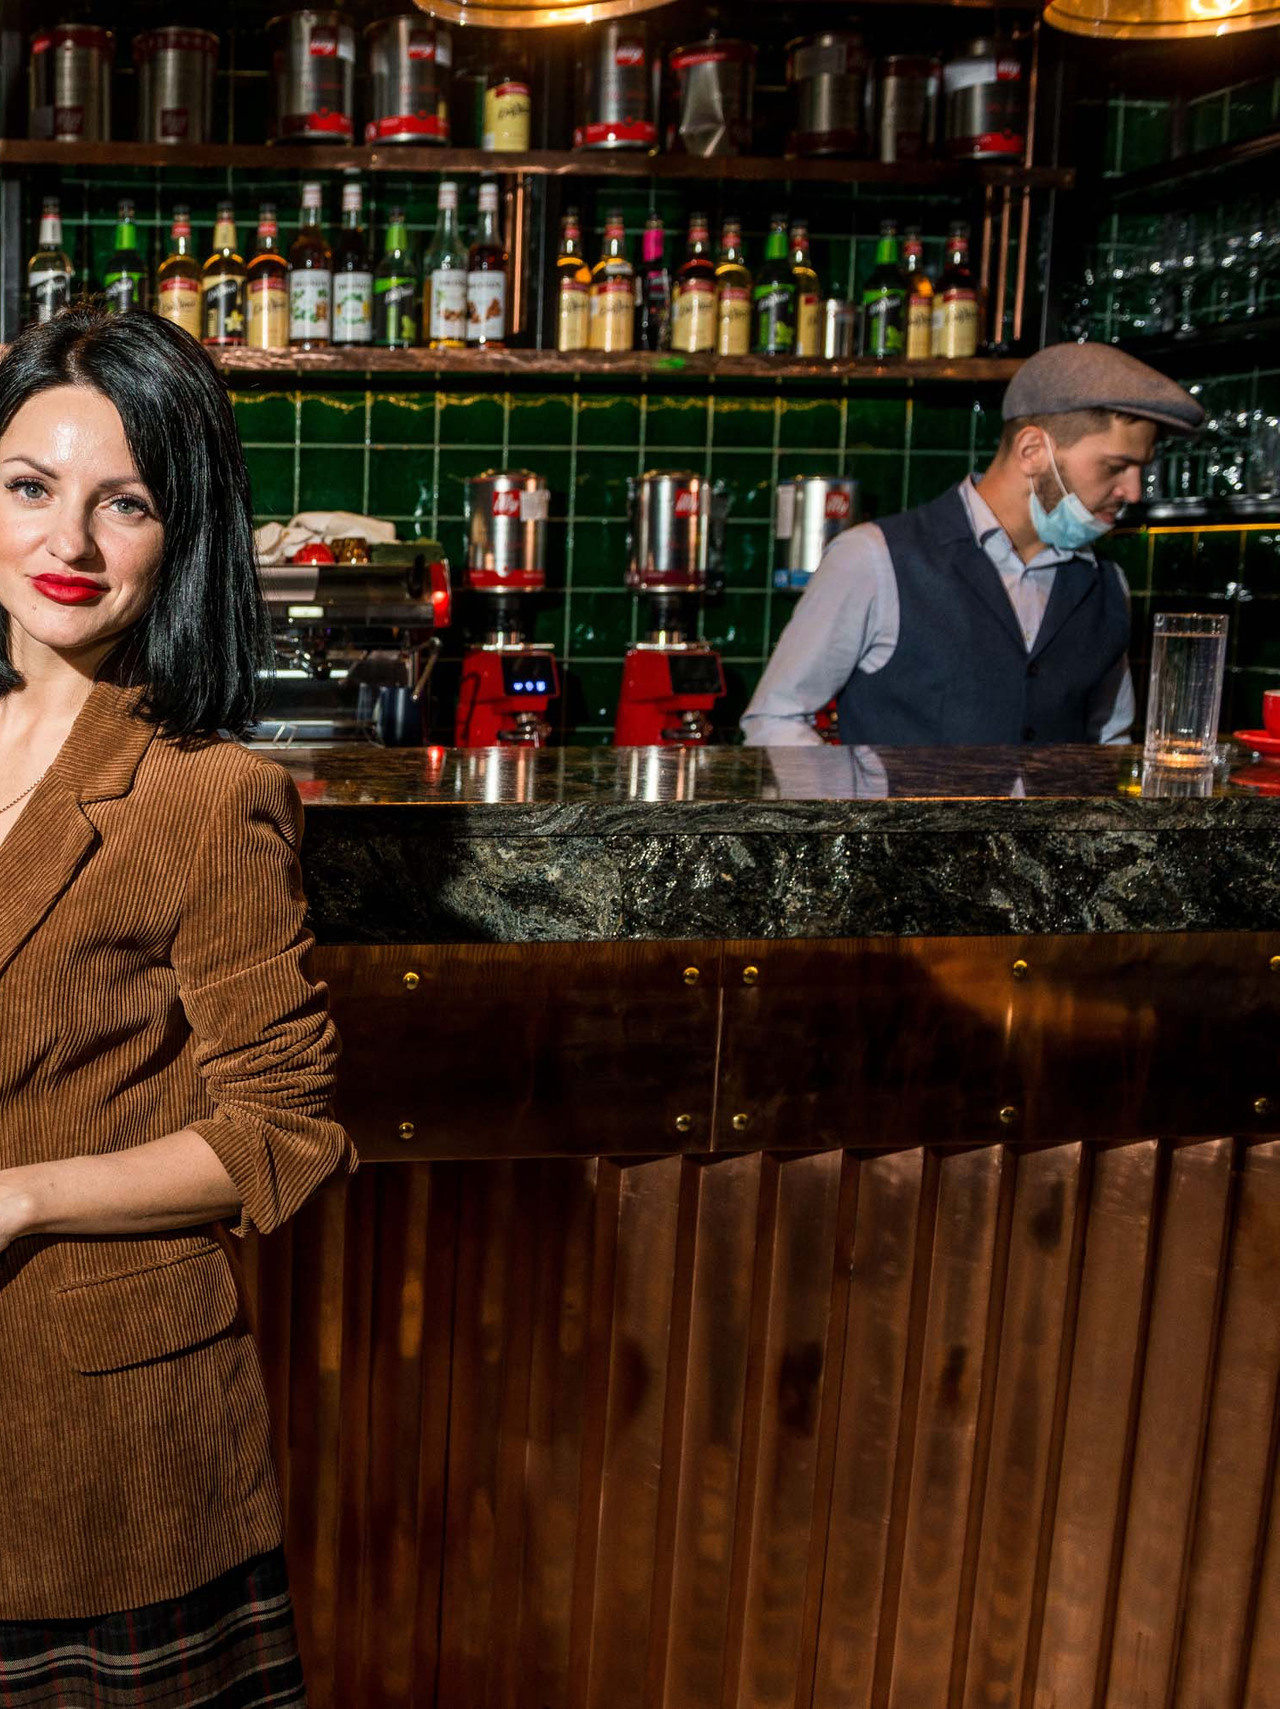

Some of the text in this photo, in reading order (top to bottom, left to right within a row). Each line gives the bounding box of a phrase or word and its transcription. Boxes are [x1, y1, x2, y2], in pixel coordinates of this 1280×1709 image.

[494, 491, 519, 514] illy
[675, 491, 698, 514] illy
[826, 494, 849, 516] illy
